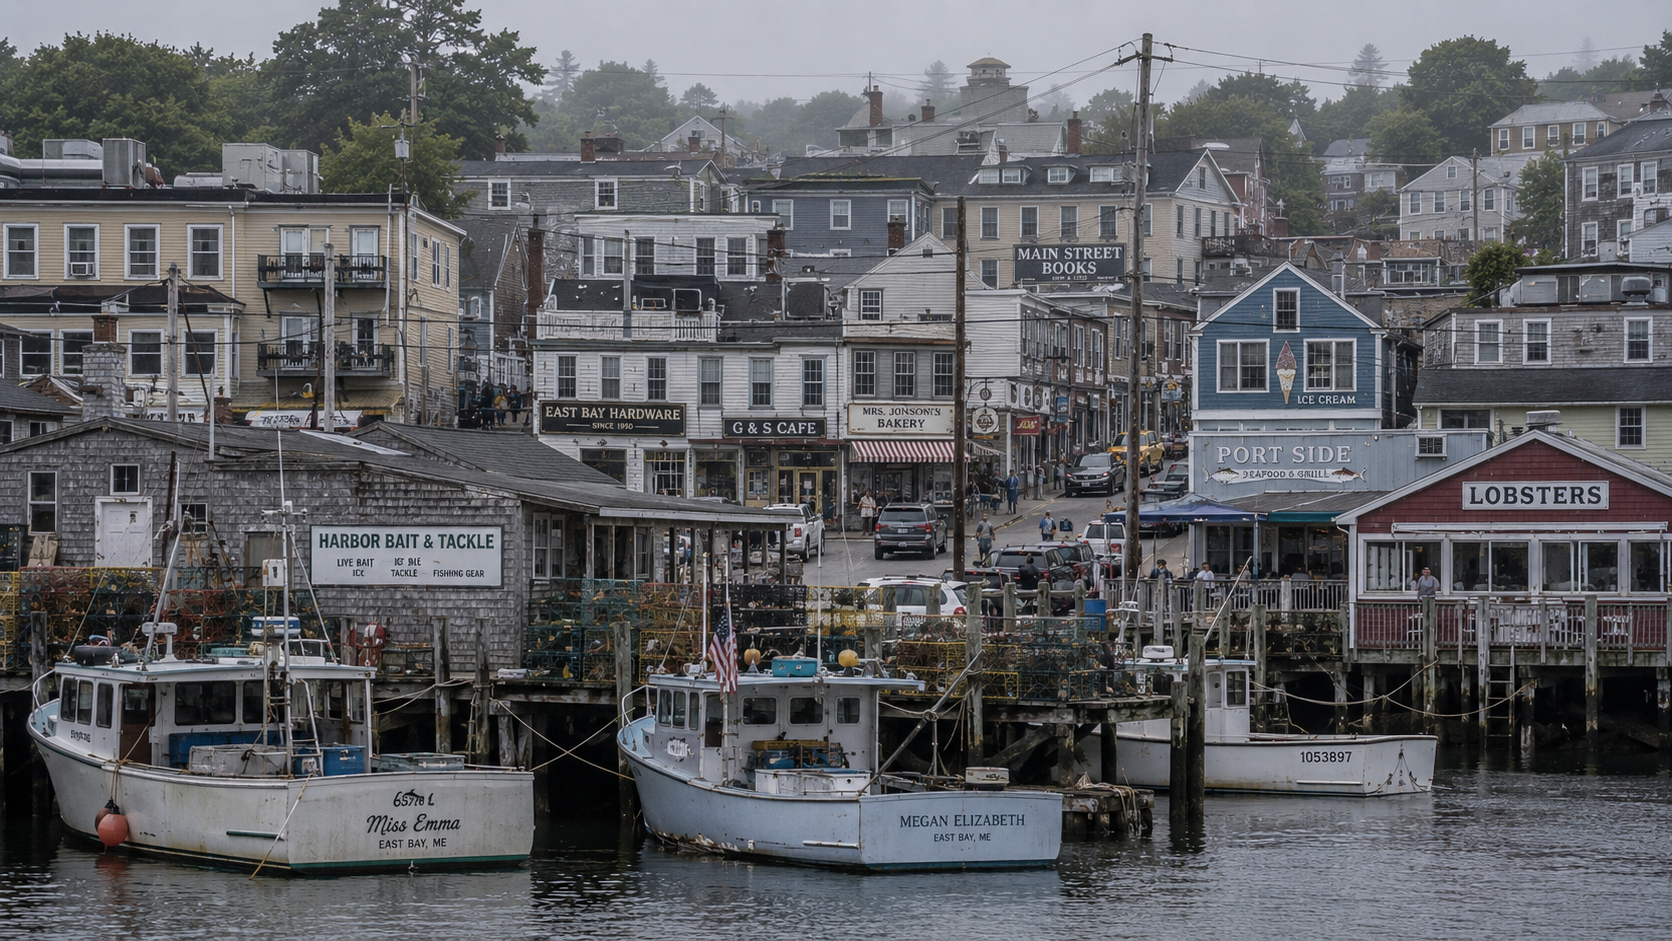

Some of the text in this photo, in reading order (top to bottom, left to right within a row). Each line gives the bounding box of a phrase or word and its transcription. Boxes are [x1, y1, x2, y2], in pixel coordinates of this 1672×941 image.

[1018, 247, 1122, 260] MAIN STREET
[1042, 261, 1097, 275] BOOKS
[1318, 395, 1356, 405] CREAM
[545, 406, 681, 420] EAST BAY HARDWARE
[862, 407, 886, 416] MRS.
[592, 422, 614, 430] SINCE
[733, 422, 817, 434] G & S CAFE
[877, 419, 925, 428] BAKERY
[1217, 445, 1352, 464] PORT SIDE
[1469, 486, 1602, 505] LOBSTERS
[319, 533, 494, 549] HARBOR BAIT & TACKLE
[337, 558, 375, 568] LIVE BAIT
[391, 569, 418, 578] TACKLE
[465, 569, 485, 578] GEAR
[1300, 751, 1352, 763] 1053897
[366, 813, 461, 836] Miss Emma
[900, 814, 1025, 828] MEGAN ELIZABETH
[933, 833, 991, 842] EAST BAY, ME
[378, 838, 447, 850] EAST BAY, ME
